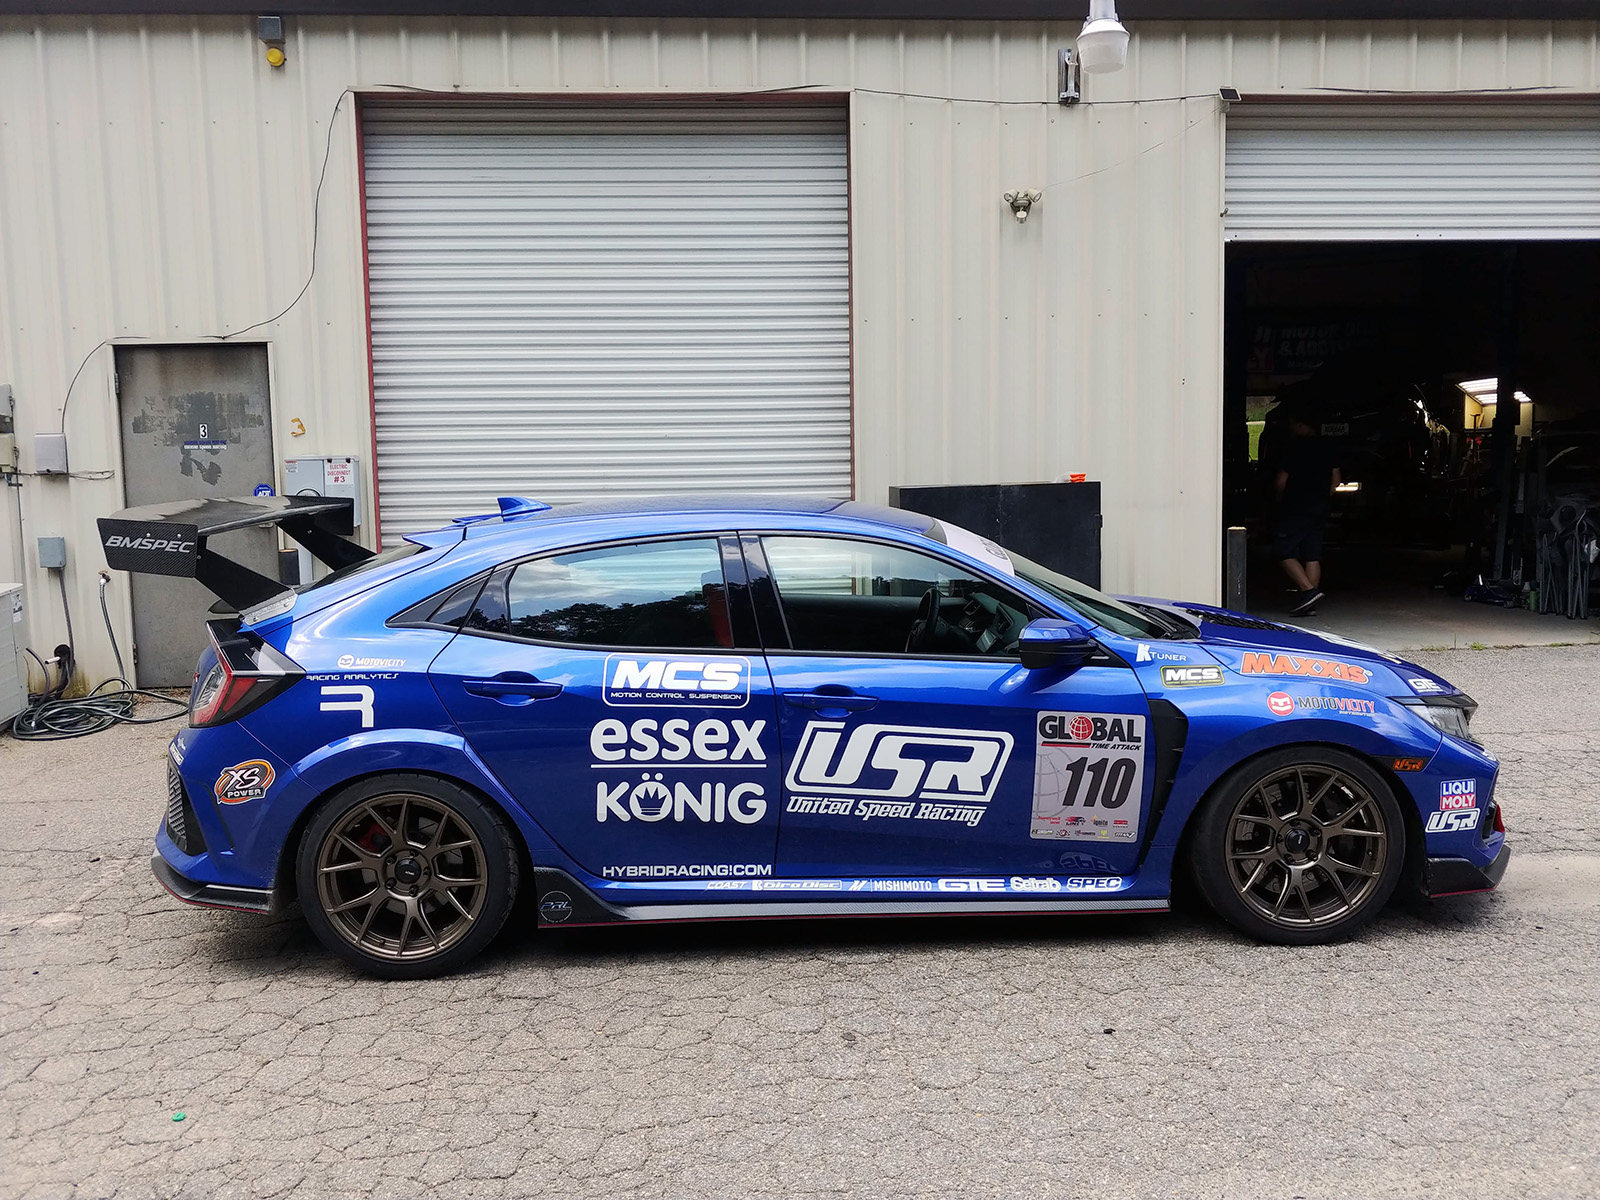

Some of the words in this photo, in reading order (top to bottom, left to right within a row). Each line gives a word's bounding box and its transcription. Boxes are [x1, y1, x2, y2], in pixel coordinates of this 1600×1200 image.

[201, 425, 207, 438] 3
[290, 417, 306, 437] 3
[105, 535, 195, 553] BMSPEC
[355, 657, 407, 667] MOTOVICITY
[1241, 651, 1369, 684] MAXXIS
[611, 660, 743, 690] MCS
[1166, 668, 1219, 681] MCS
[1298, 696, 1375, 713] MOTOVICITY
[1038, 715, 1142, 743] GLOBAL
[590, 718, 767, 761] essex
[1091, 742, 1110, 750] TIME
[1110, 743, 1141, 751] ATTACK
[785, 720, 1014, 802] USR
[1393, 759, 1423, 771] USR
[220, 767, 261, 797] XS
[1062, 756, 1137, 809] 110
[1442, 781, 1474, 796] LIQUI
[227, 789, 261, 798] POWER
[596, 772, 767, 824] KÖNIG
[1442, 795, 1475, 809] MOLY
[786, 796, 855, 815] United
[854, 800, 916, 821] Speed
[914, 803, 987, 827] Racing
[1425, 808, 1480, 833] USR
[705, 880, 748, 890] COAST
[874, 880, 932, 891] MISHIMOTO
[938, 879, 1006, 892] GTE
[1010, 877, 1061, 891] Setrab
[1068, 878, 1121, 889] SPEC
